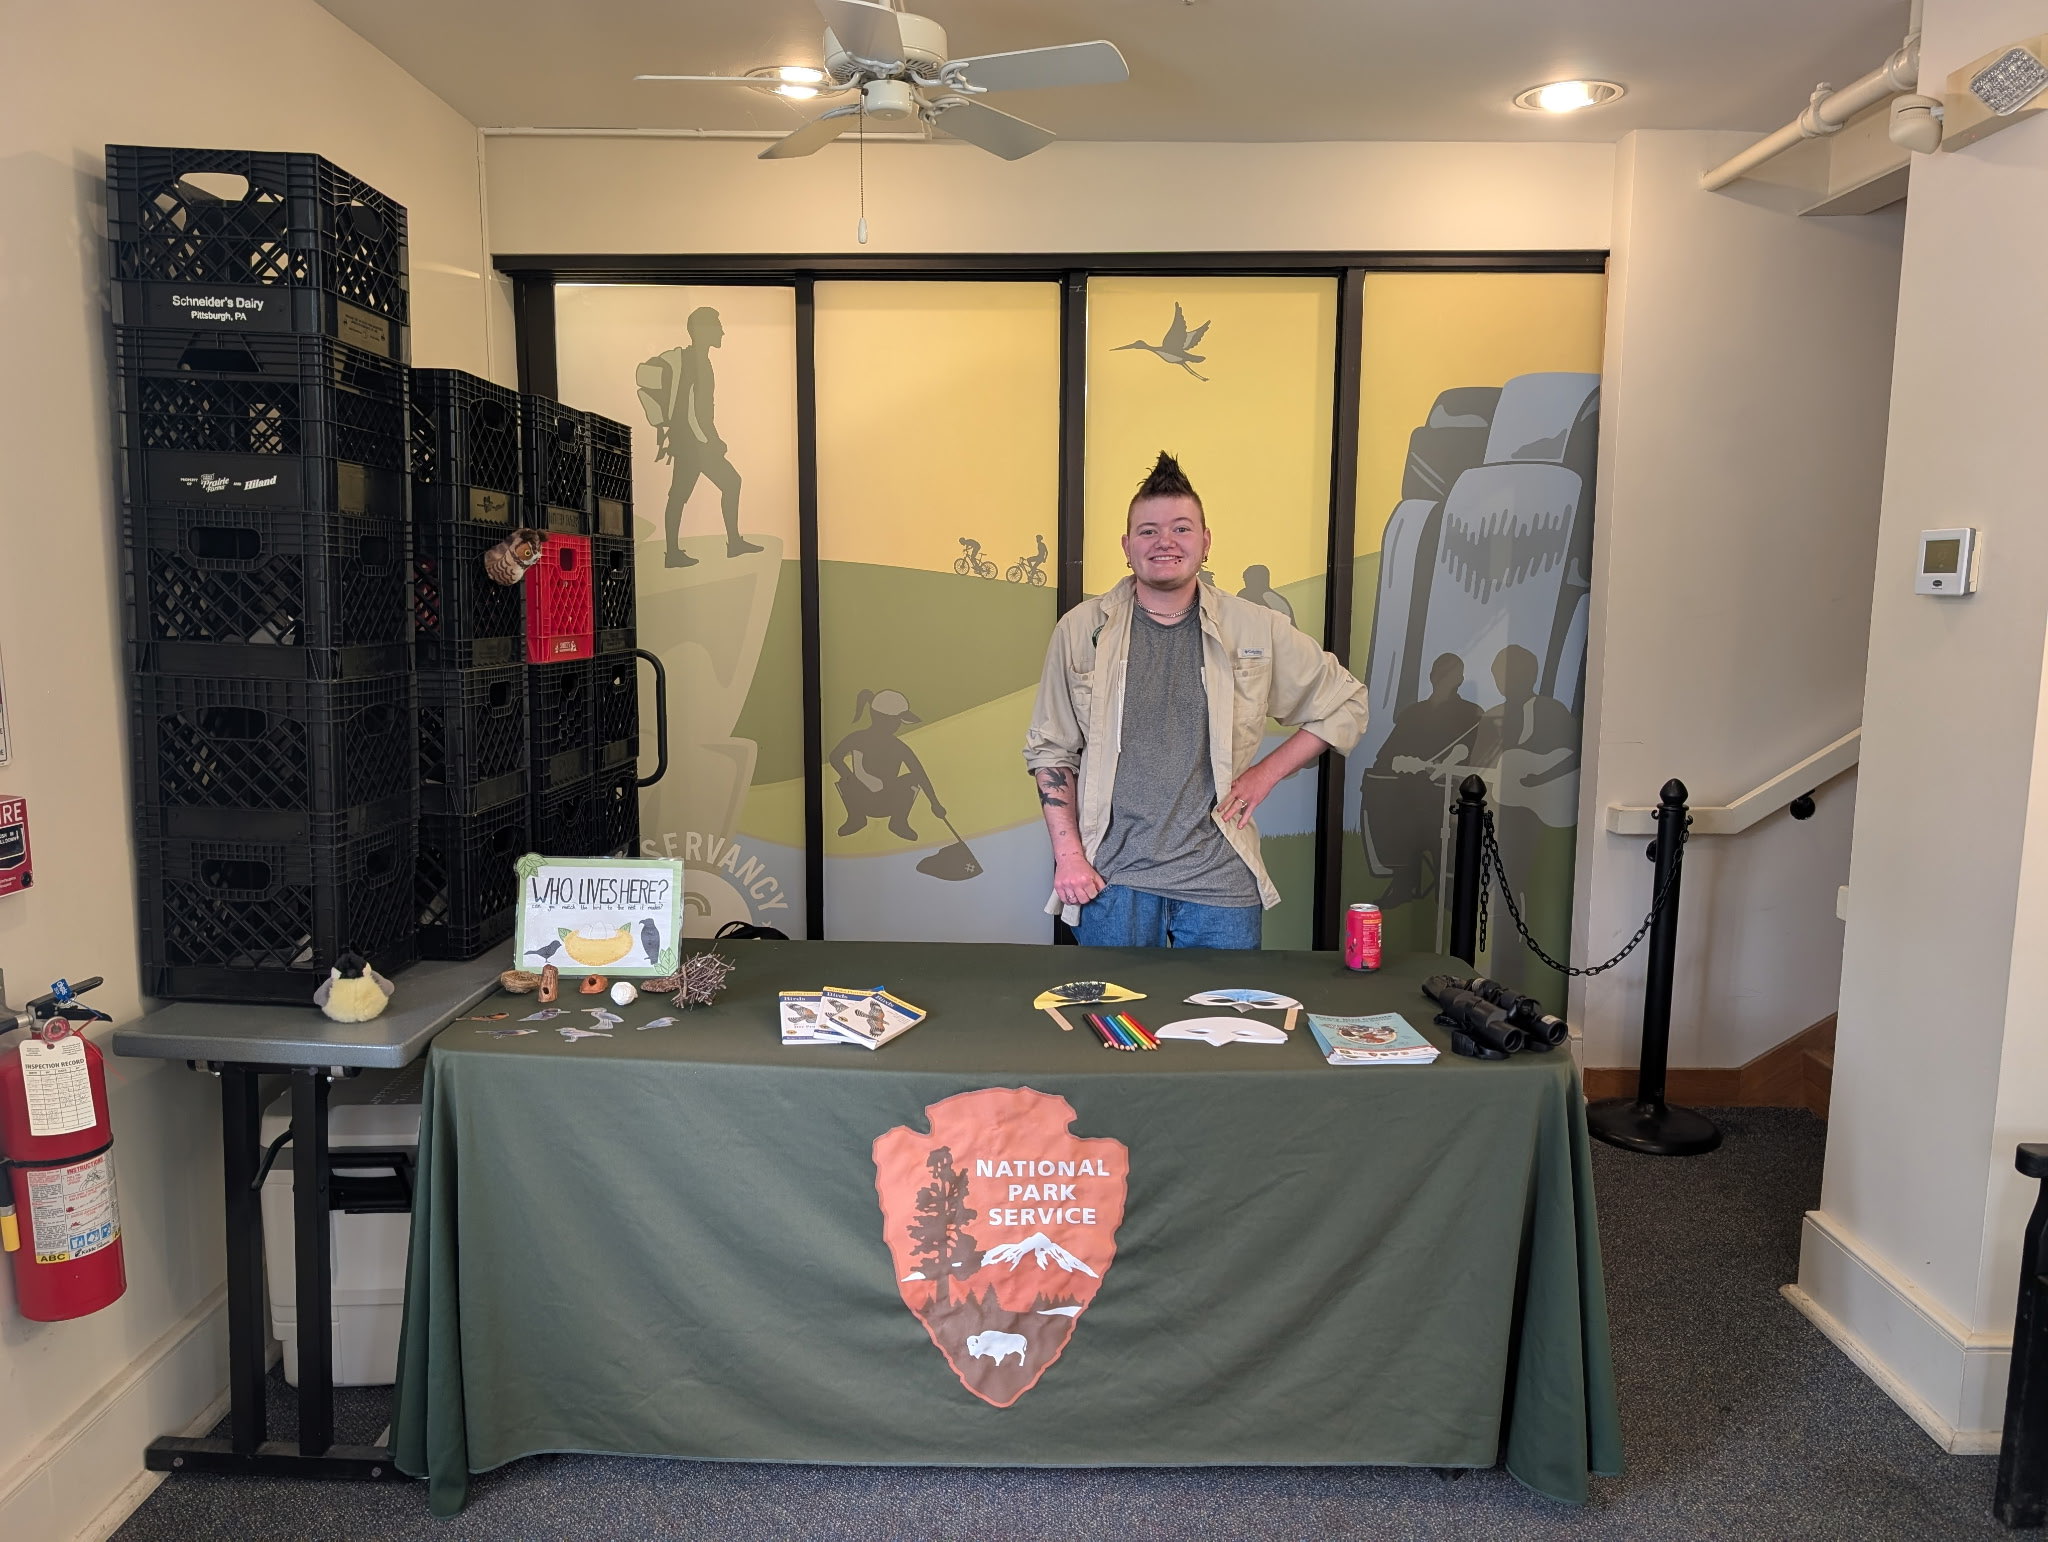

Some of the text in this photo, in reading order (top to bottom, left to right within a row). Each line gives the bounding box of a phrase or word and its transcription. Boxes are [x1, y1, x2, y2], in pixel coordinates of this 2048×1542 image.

[172, 295, 264, 311] Schneider's Dairy
[190, 310, 247, 322] Pittsburgh, PA
[243, 475, 278, 490] Hiland
[0, 802, 23, 825] RE
[531, 877, 669, 904] WHO LIVES HERE?
[25, 1058, 84, 1070] INSPECTION RECORD
[975, 1159, 1111, 1178] NATIONAL
[1008, 1183, 1077, 1202] PARK
[988, 1207, 1097, 1226] SERVICE
[40, 1253, 66, 1262] ABC
